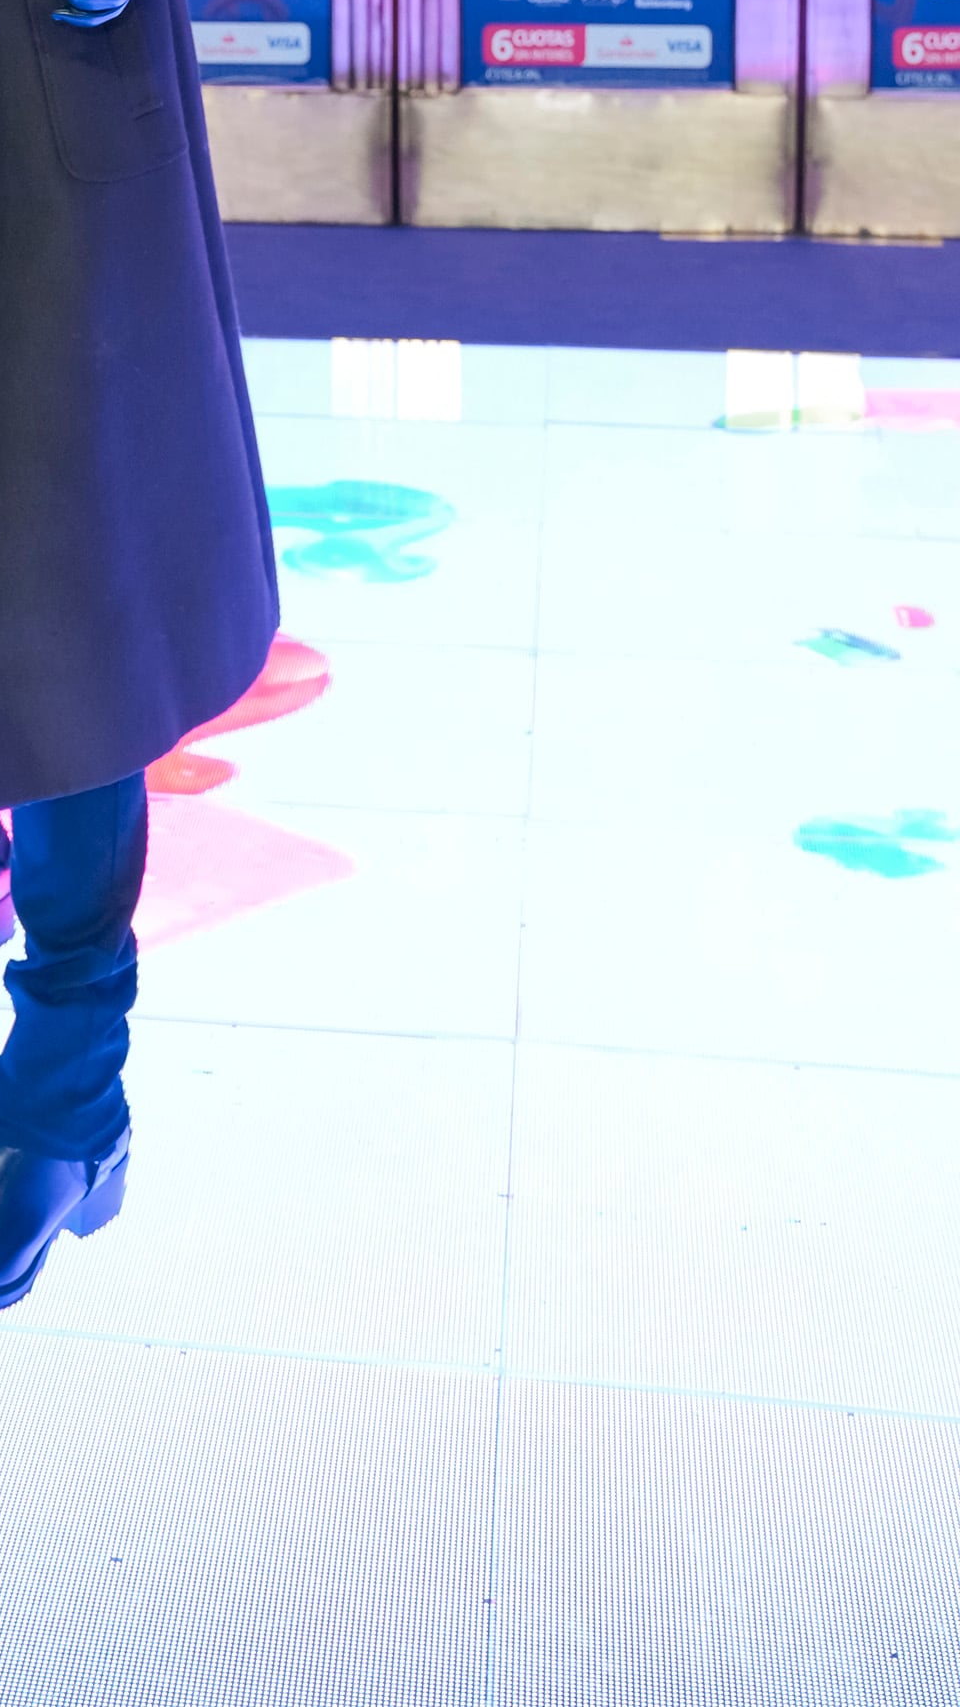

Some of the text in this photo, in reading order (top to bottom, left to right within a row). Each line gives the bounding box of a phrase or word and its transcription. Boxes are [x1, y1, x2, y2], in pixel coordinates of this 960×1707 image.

[491, 29, 576, 61] 6 CUOTAS
[667, 40, 702, 52] VISA
[901, 32, 925, 65] 6
